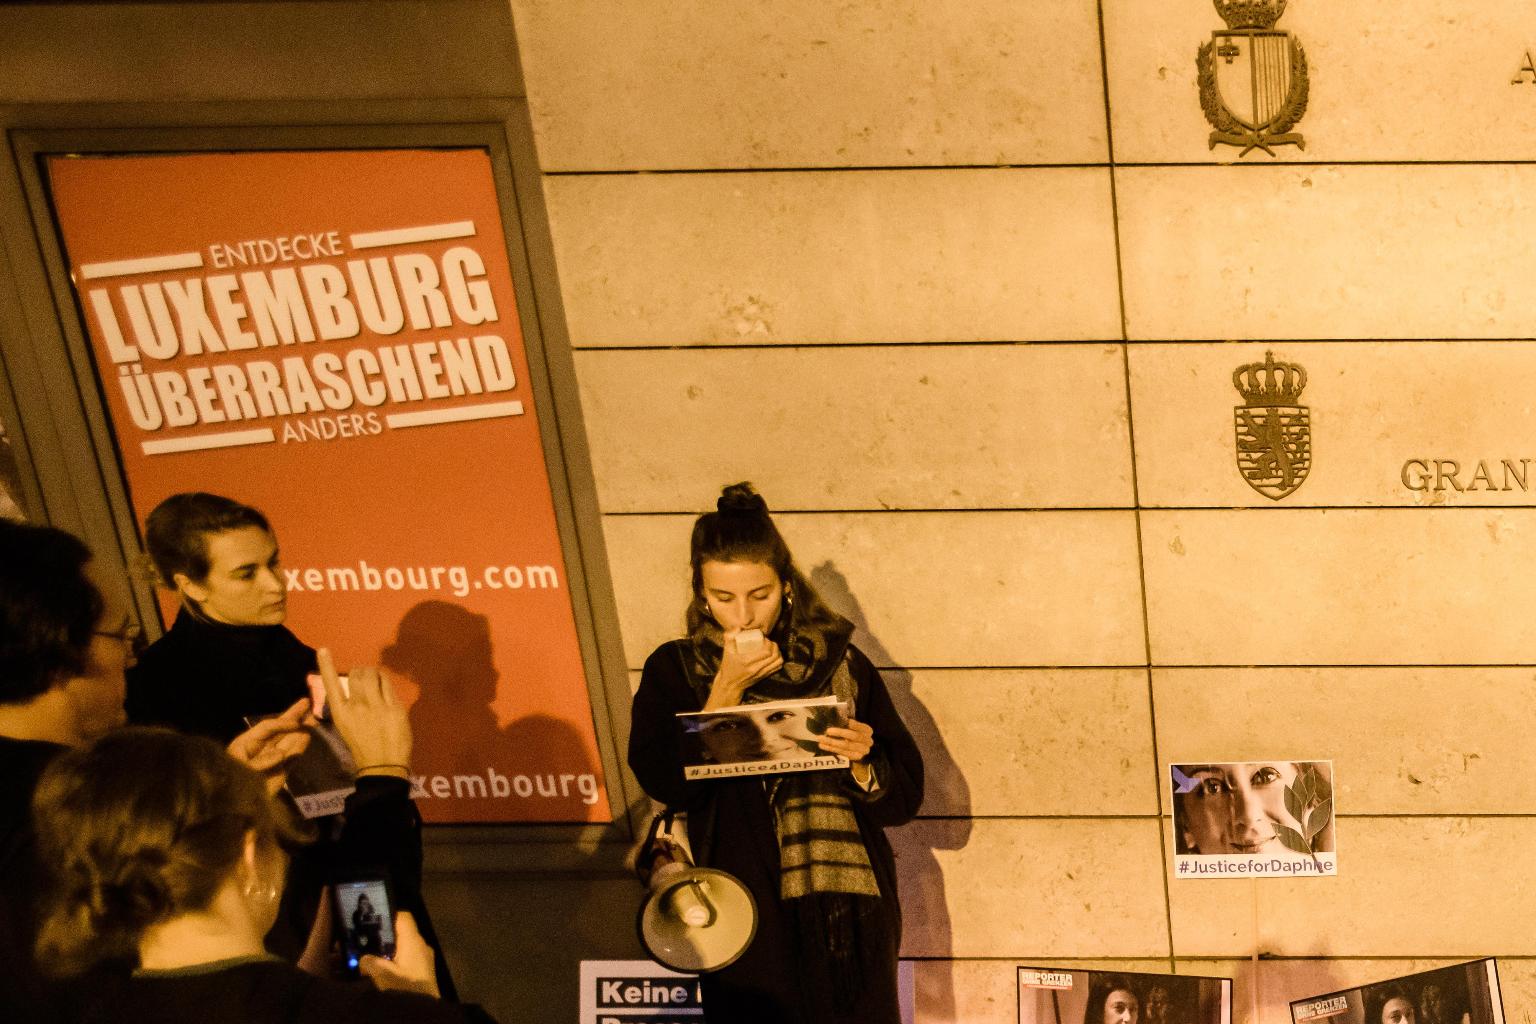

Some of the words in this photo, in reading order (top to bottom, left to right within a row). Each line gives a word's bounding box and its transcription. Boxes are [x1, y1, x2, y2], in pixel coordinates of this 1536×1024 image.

[209, 231, 344, 268] ENTDECKE
[89, 246, 498, 363] LUXEMBURG
[119, 335, 517, 431] ÜBERRASCHEND
[283, 412, 383, 444] ANDERS
[285, 561, 559, 597] xembourg.com
[690, 758, 847, 777] #Justice4Daphne
[409, 768, 599, 804] xembourg
[602, 980, 688, 1003] Keine
[1022, 971, 1073, 981] REPORTER
[1296, 996, 1347, 1011] REPORTER
